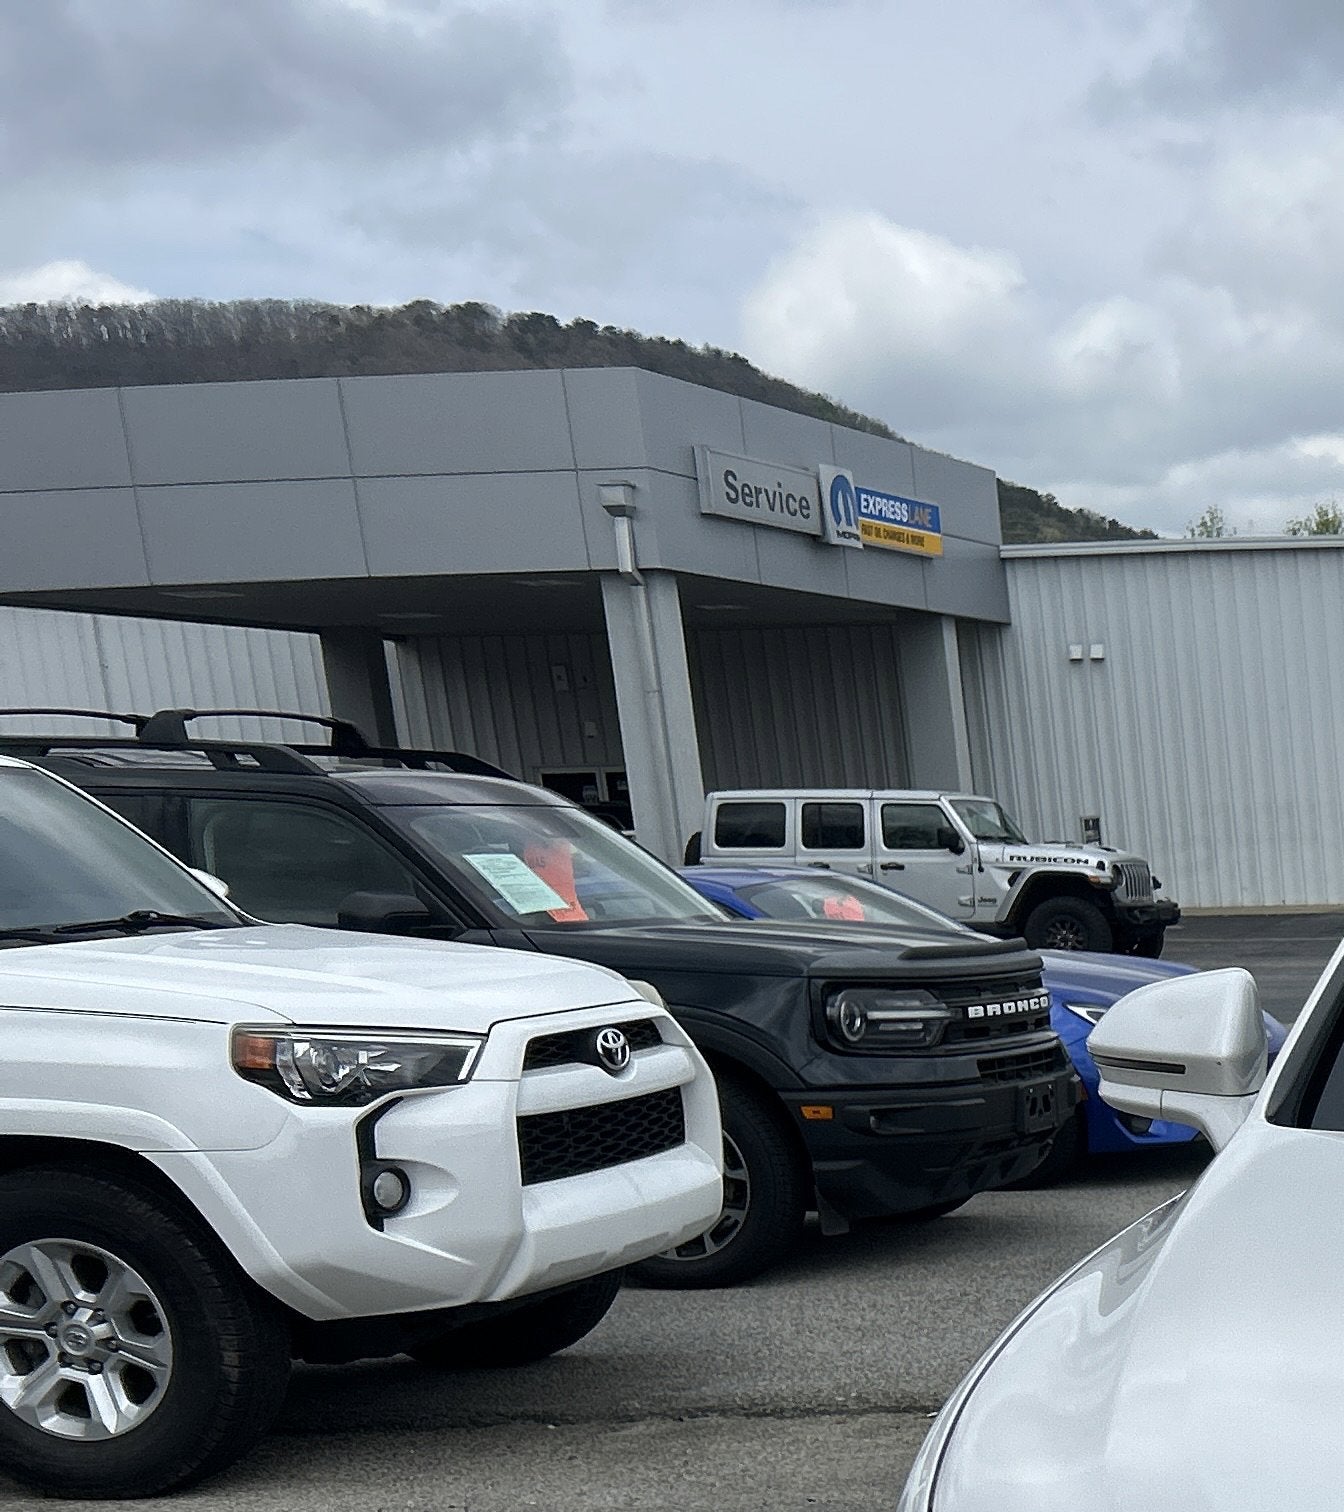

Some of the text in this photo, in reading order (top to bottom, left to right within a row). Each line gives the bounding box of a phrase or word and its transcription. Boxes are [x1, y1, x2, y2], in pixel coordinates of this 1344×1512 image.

[724, 470, 810, 519] Service
[860, 494, 908, 522] EXPRESS
[1010, 855, 1089, 864] RUBICON
[968, 996, 1048, 1018] BRONCO
